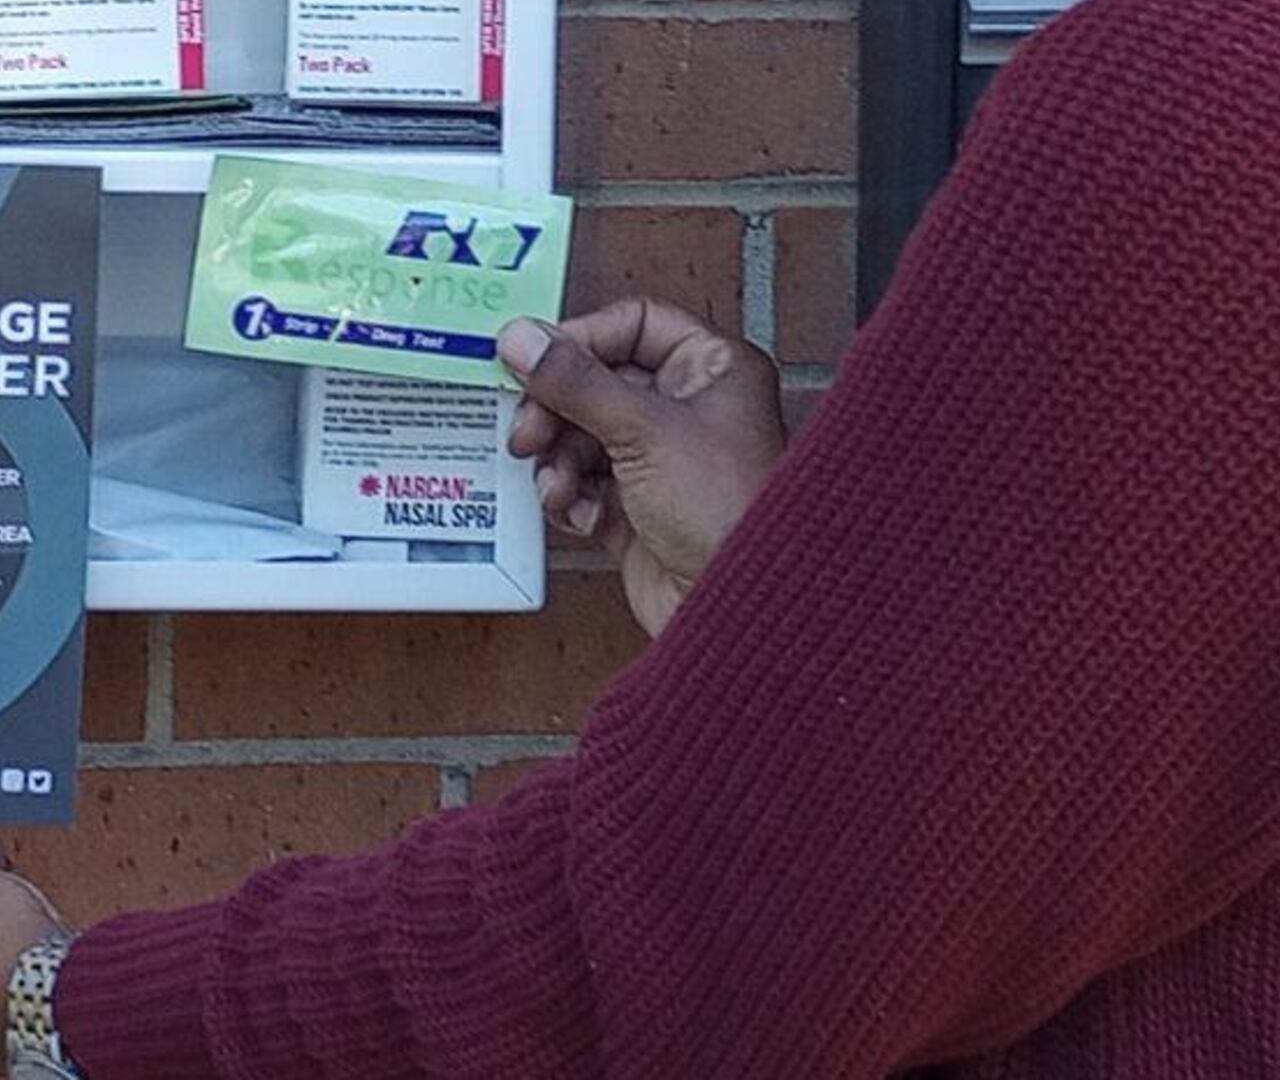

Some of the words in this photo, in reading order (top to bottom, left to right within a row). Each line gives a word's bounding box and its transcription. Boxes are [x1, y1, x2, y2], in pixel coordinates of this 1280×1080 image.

[28, 53, 68, 70] Pack
[298, 56, 329, 72] Two
[333, 56, 371, 74] Pack
[413, 333, 446, 349] Test
[386, 474, 466, 501] NARCAN
[385, 502, 447, 528] NASAL
